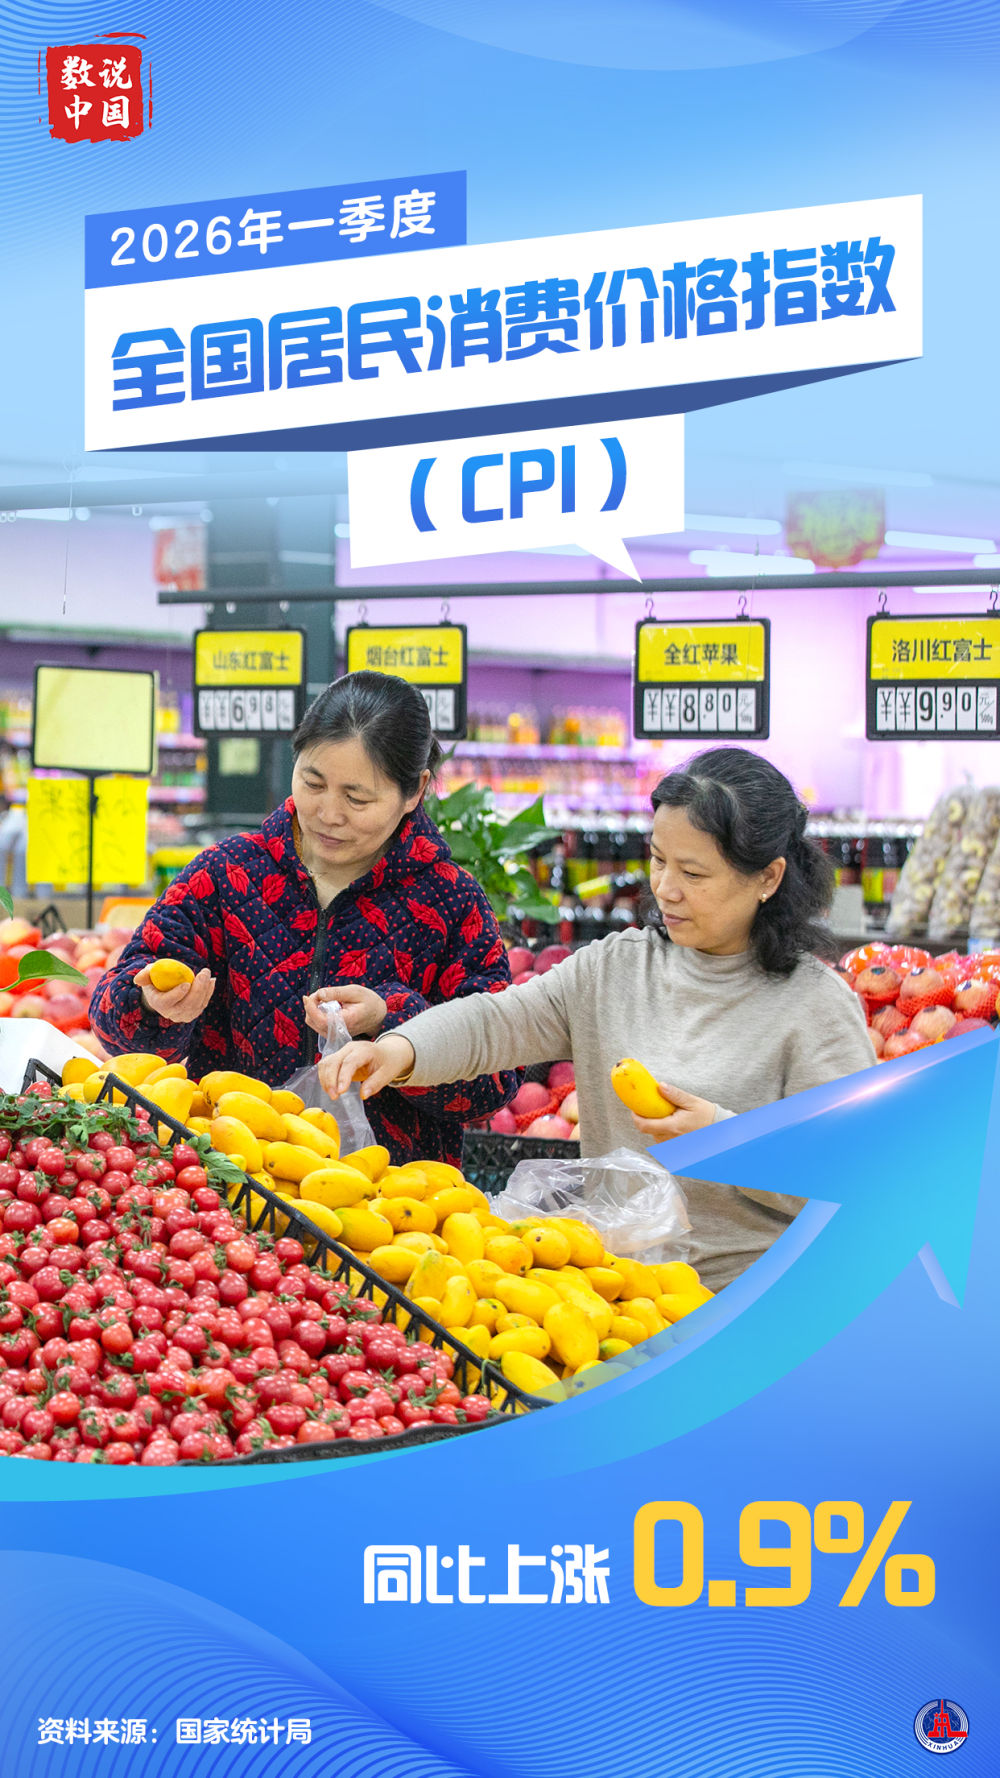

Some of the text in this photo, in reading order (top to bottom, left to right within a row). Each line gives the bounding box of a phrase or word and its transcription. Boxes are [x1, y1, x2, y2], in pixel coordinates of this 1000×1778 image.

[213, 650, 290, 671] 山东红富士
[366, 645, 449, 668] 烟台红富士
[664, 643, 738, 666] 全红苹果
[892, 637, 993, 662] 洛川红富士
